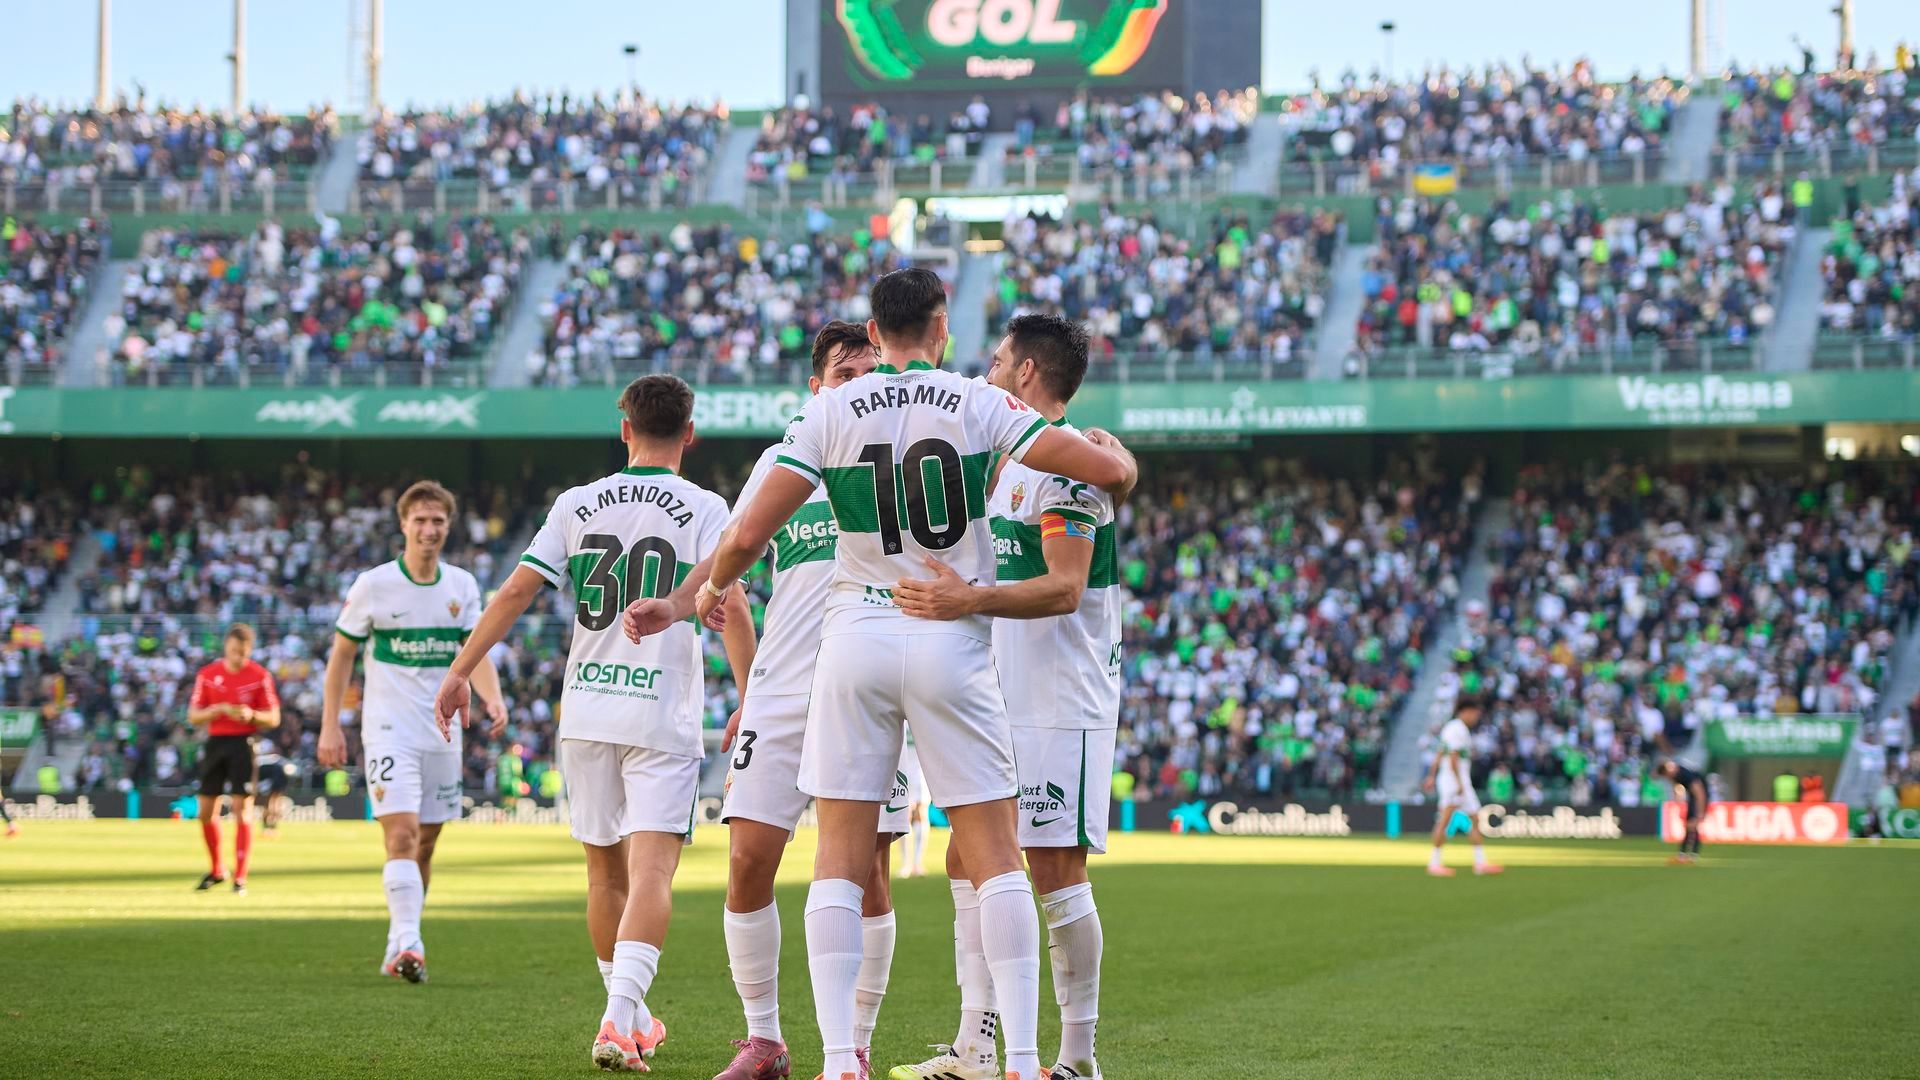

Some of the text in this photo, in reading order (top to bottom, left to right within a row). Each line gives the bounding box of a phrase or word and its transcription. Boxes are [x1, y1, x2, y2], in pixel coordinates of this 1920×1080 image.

[928, 0, 1077, 46] GOL
[857, 437, 969, 557] 10
[577, 533, 677, 632] 30
[584, 685, 659, 701] Climatización eficiente
[369, 756, 394, 784] 22
[1208, 801, 1351, 836] CaixaBank
[1478, 804, 1622, 839] CaixaBank
